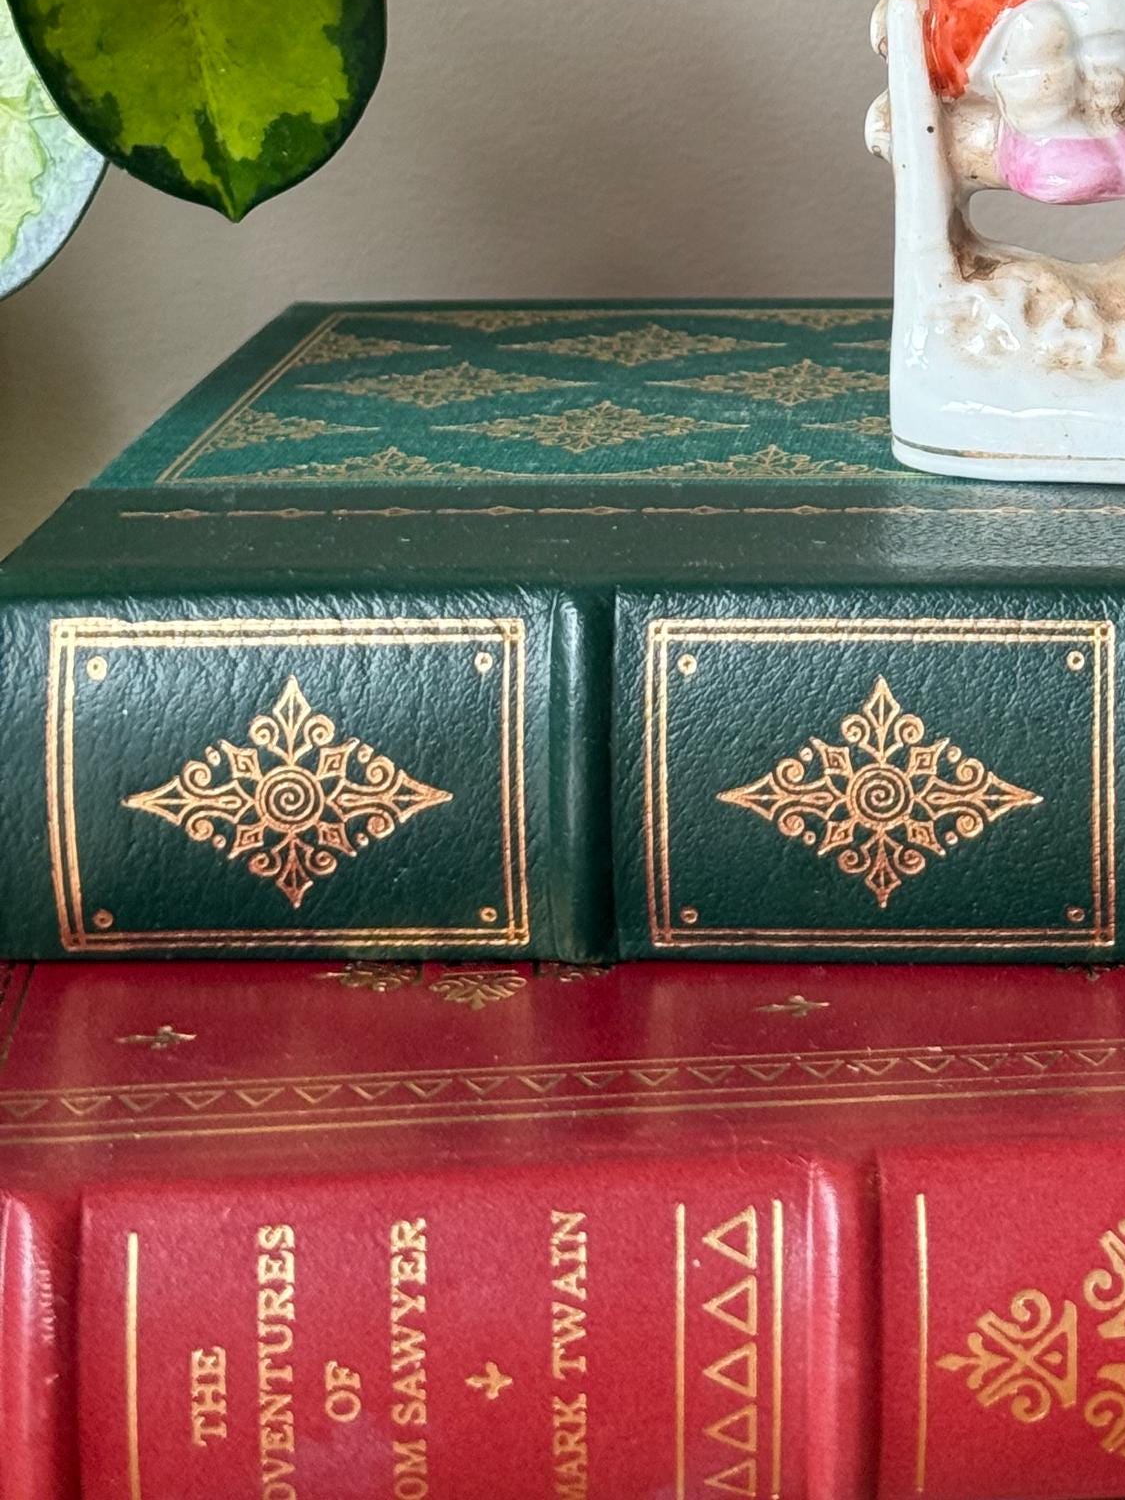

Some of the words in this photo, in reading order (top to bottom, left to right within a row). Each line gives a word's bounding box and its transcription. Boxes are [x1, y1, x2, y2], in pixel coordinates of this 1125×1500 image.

[390, 1217, 427, 1426] SAWYER
[550, 1210, 587, 1379] TWAIN
[191, 1346, 227, 1446] THE
[257, 1224, 296, 1500] DVENTURES
[325, 1360, 362, 1422] OF
[391, 1438, 427, 1500] OM
